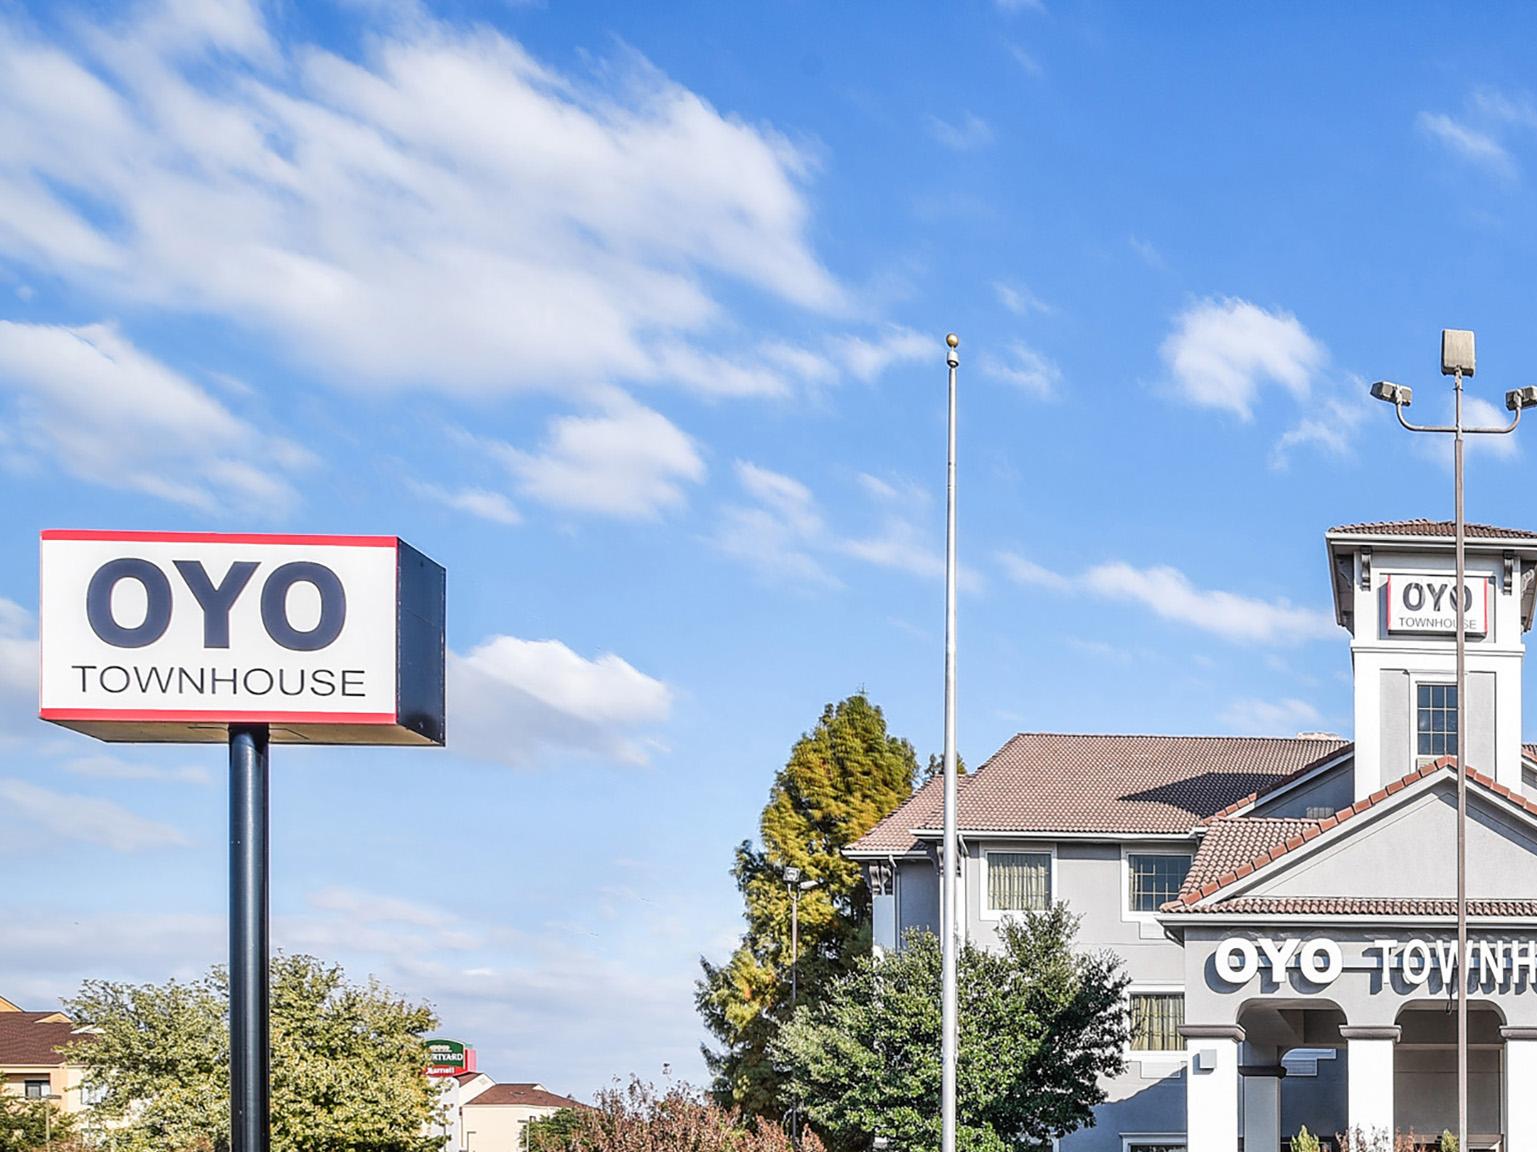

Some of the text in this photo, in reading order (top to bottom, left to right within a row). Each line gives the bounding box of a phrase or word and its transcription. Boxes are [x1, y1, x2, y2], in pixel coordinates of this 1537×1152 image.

[86, 557, 347, 652] OYO
[1402, 582, 1473, 613] OYO
[71, 665, 366, 697] TOWNHOUSE
[1215, 937, 1344, 984] OYO
